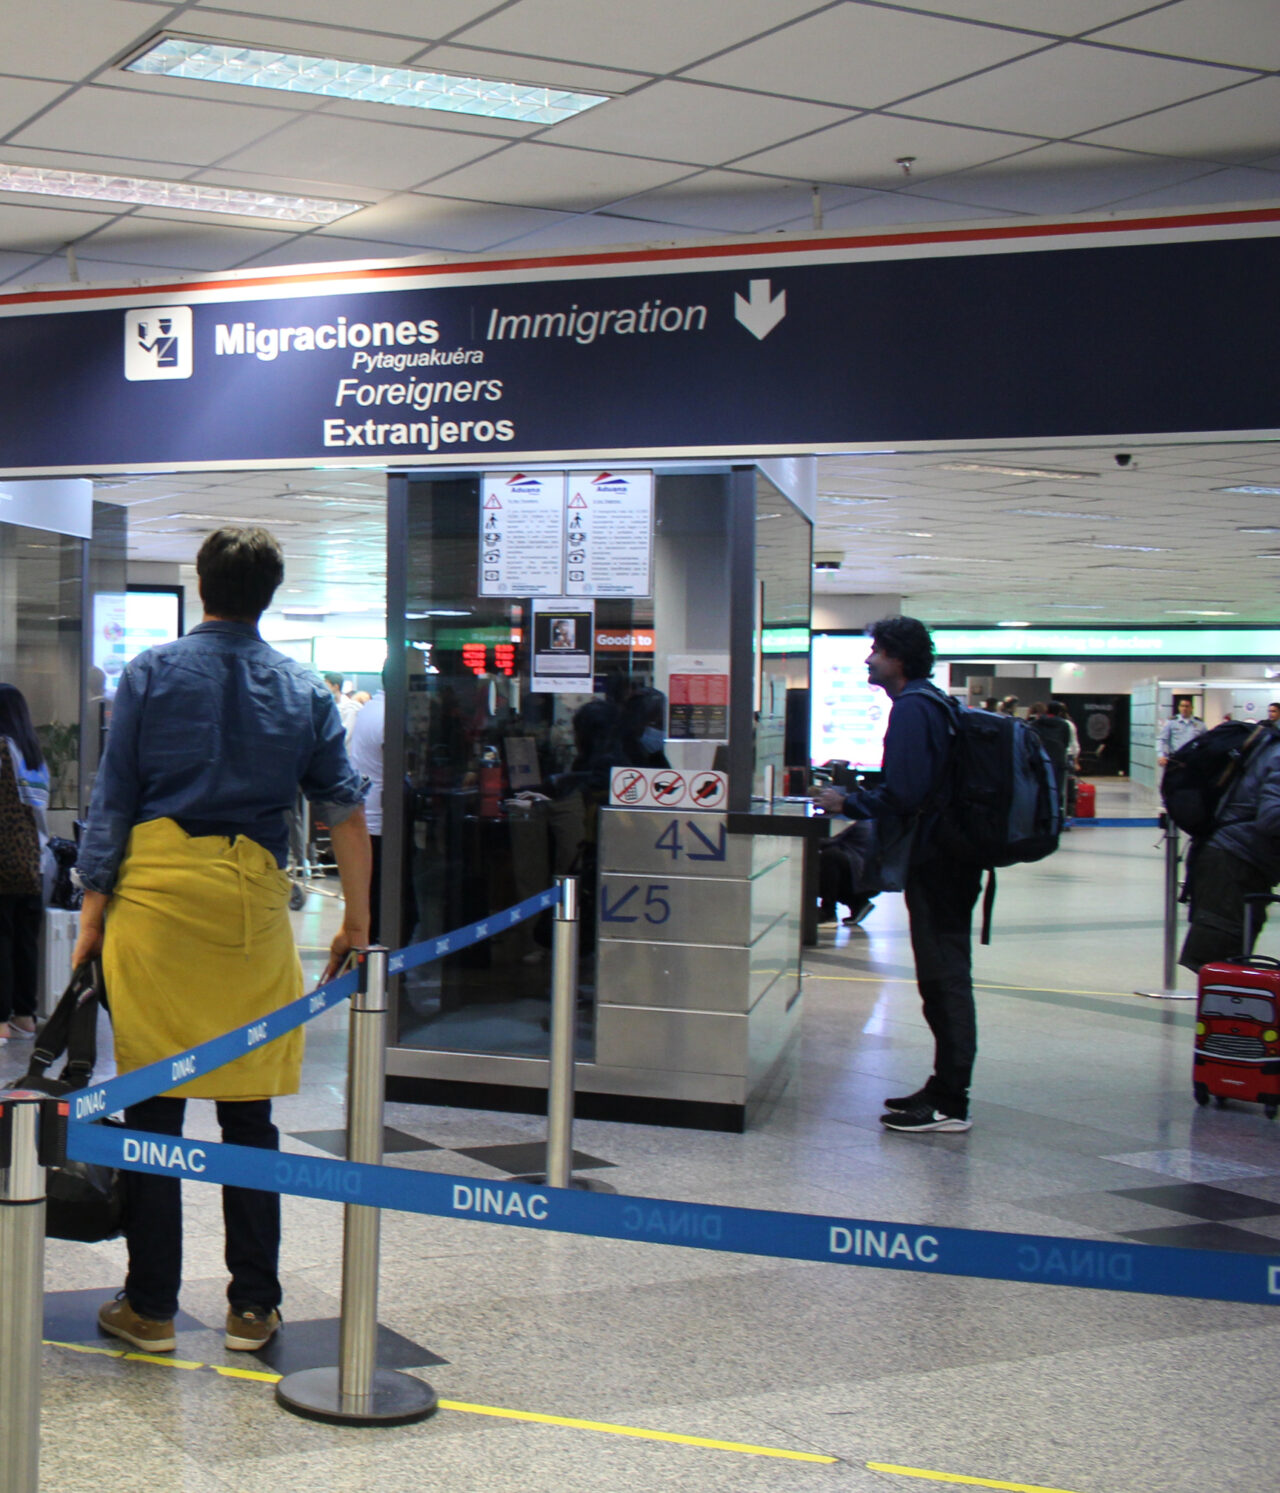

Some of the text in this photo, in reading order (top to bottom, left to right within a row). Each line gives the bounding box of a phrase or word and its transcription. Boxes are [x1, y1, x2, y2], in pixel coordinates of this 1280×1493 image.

[215, 299, 708, 361] Migraciones Immigration
[352, 347, 484, 373] Pytaguakuéra
[335, 376, 504, 411] Foreigners
[323, 415, 515, 451] Extranjeros
[597, 634, 652, 646] Goods to
[655, 819, 683, 860] 4
[644, 885, 670, 925] 5
[247, 1022, 267, 1046] DINAC
[172, 1055, 196, 1082] DINAC
[76, 1089, 107, 1120] DINAC
[123, 1138, 206, 1173] DINAC
[453, 1184, 549, 1221] DINAC
[829, 1226, 939, 1263] DINAC
